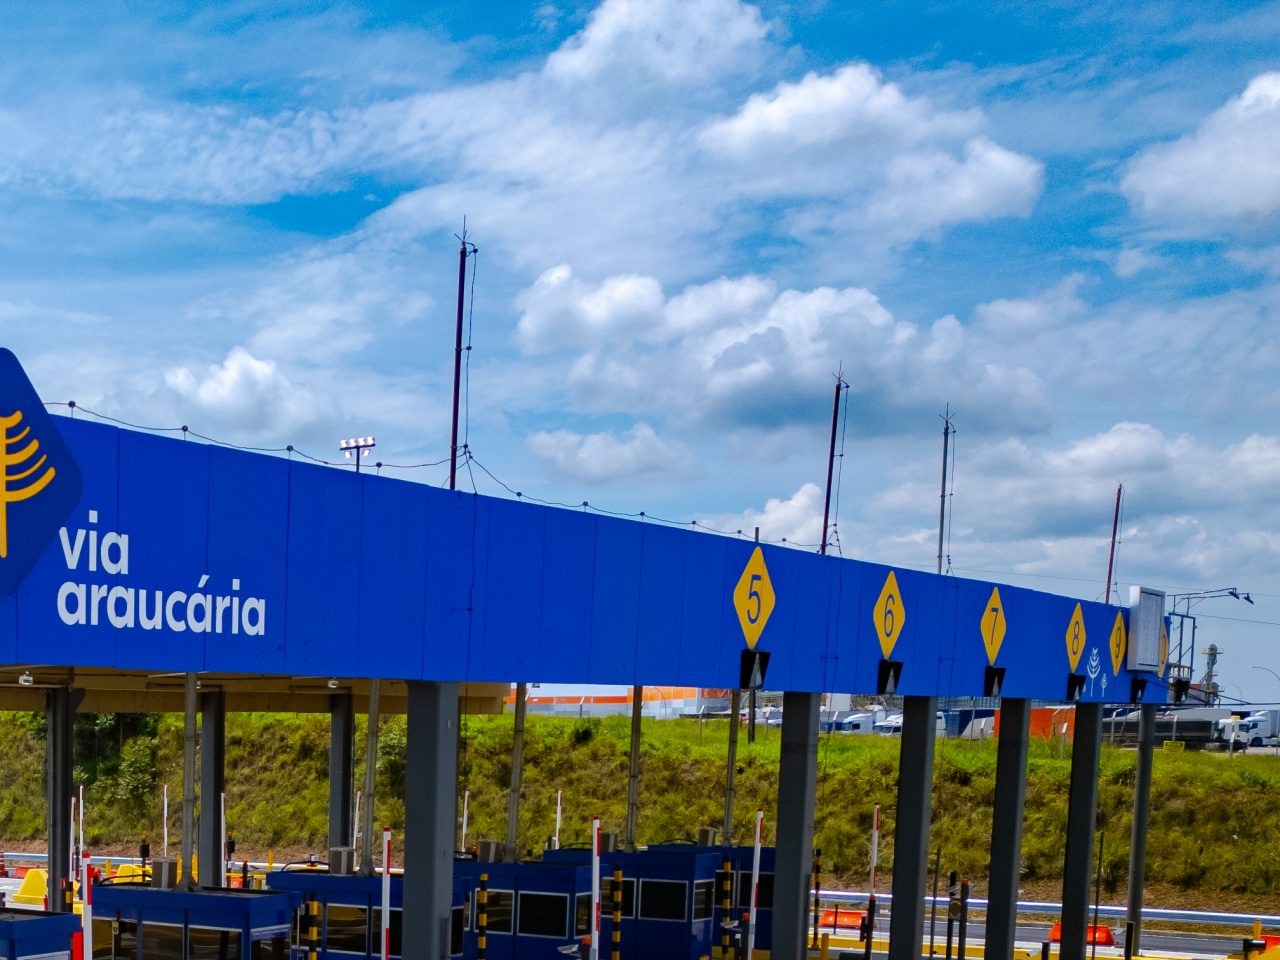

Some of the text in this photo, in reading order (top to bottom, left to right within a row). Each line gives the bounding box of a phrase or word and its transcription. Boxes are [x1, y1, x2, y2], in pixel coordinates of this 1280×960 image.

[59, 510, 129, 574] via
[57, 574, 265, 636] araucária
[747, 574, 761, 624] 5
[884, 594, 895, 637] 6
[991, 608, 1000, 646] 7
[1072, 621, 1080, 655] 8
[1114, 627, 1121, 659] 9
